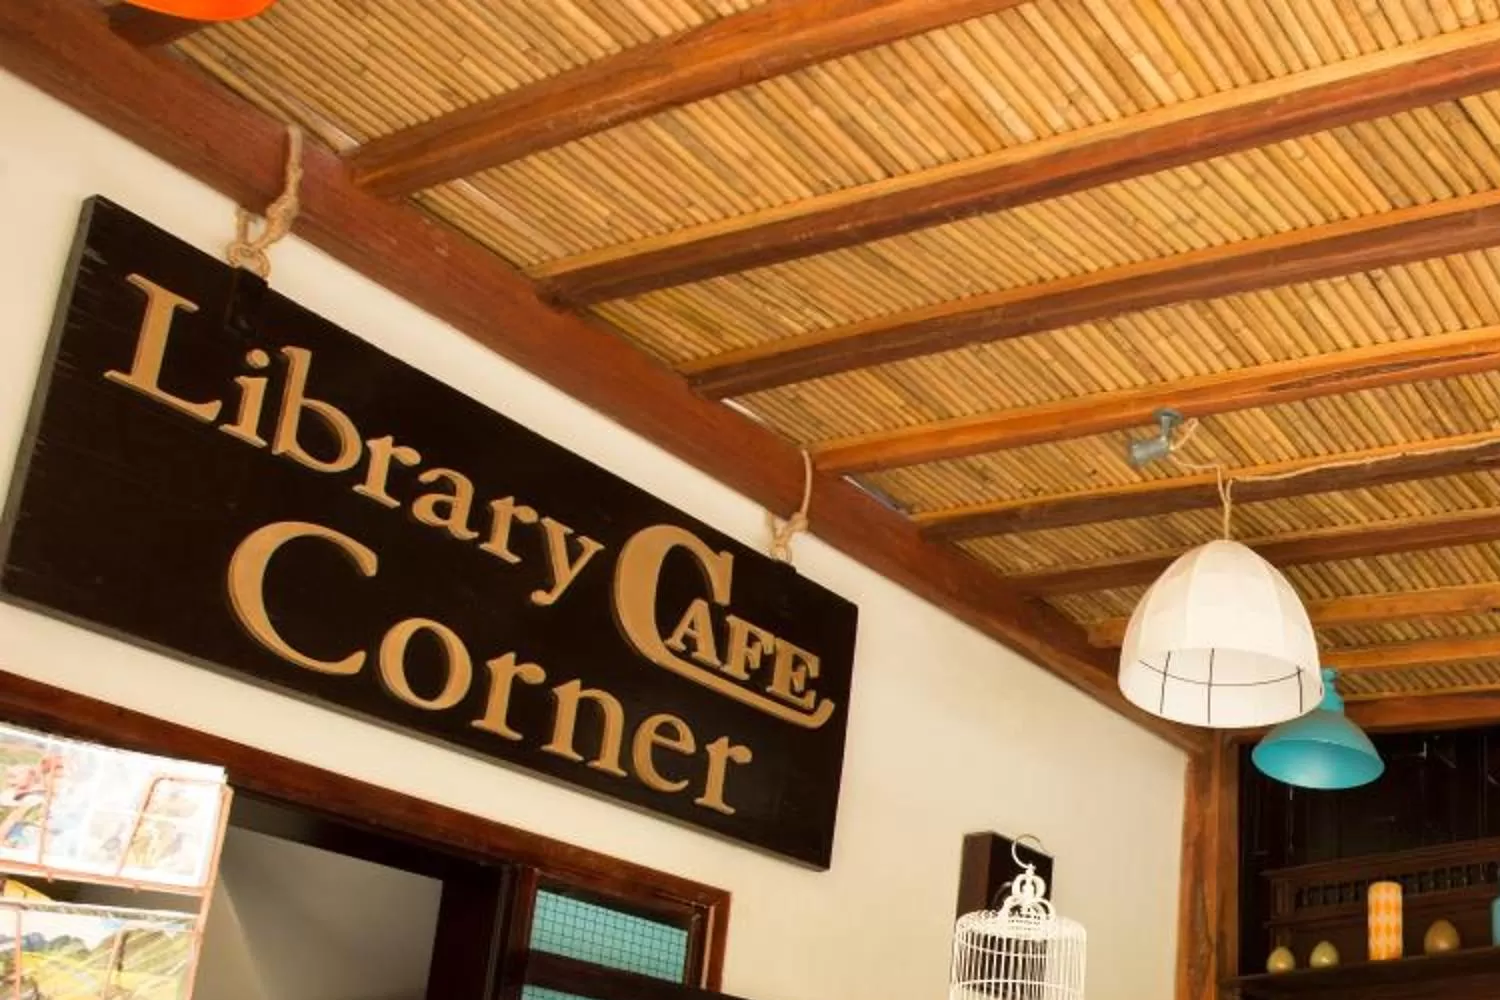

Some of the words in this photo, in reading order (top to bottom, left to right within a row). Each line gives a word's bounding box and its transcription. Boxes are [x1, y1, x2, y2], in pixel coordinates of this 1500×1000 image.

[104, 273, 606, 607] Library
[228, 519, 754, 816] Corner
[612, 523, 836, 729] CAFE
